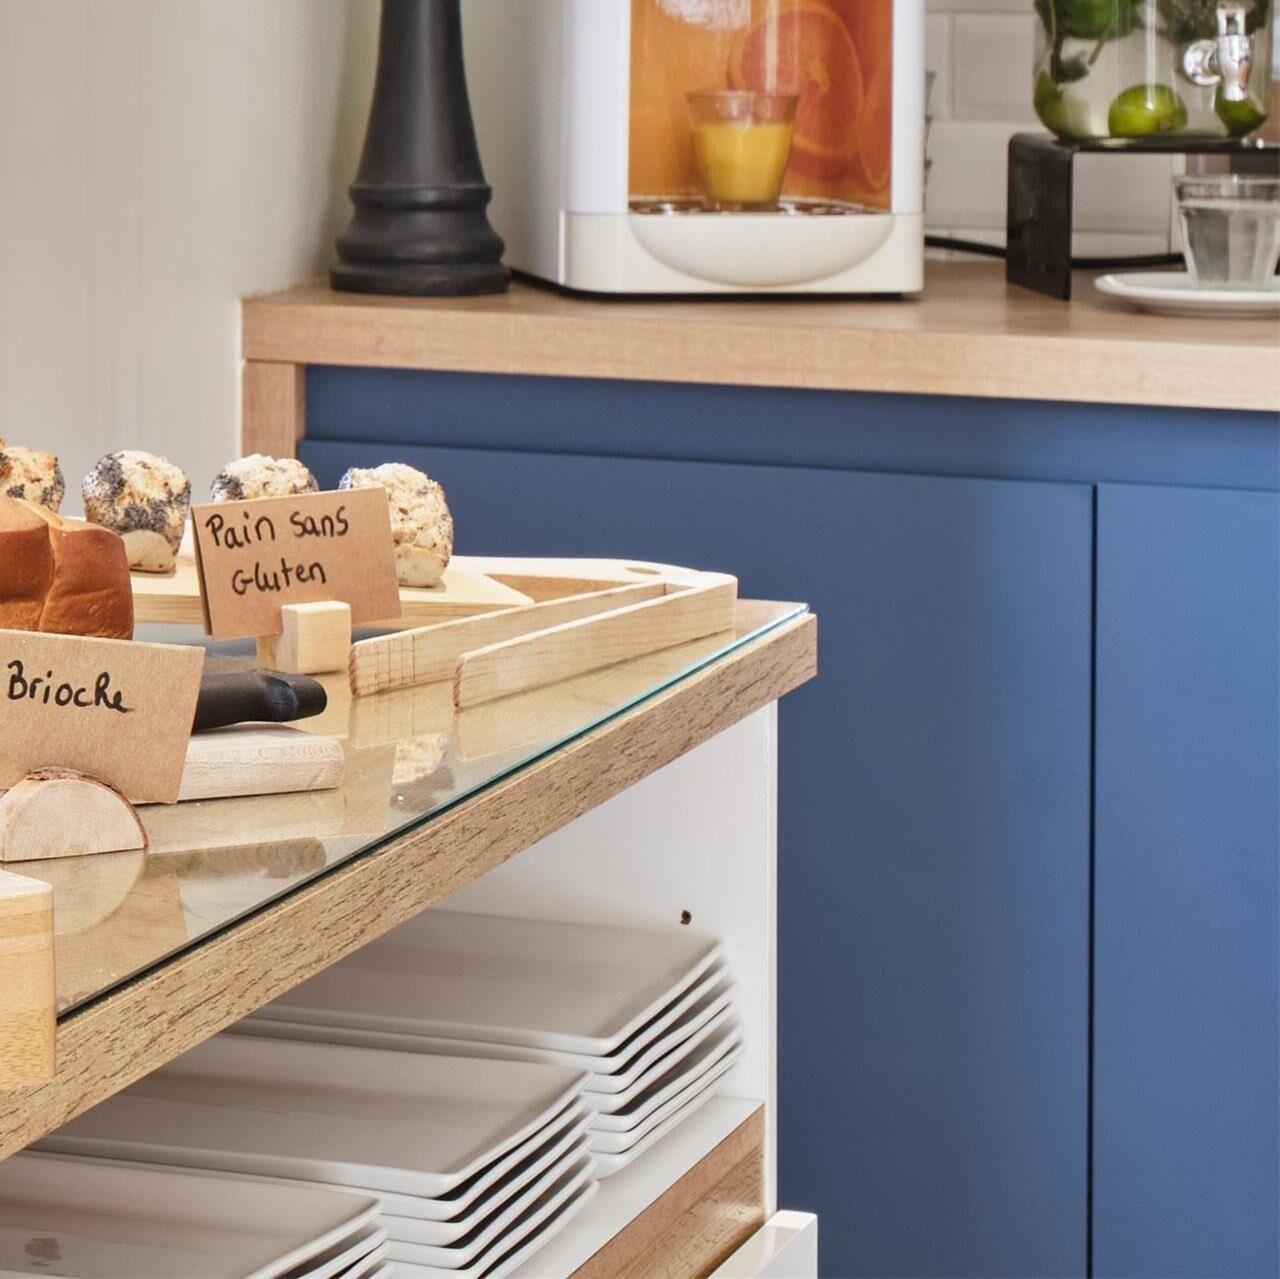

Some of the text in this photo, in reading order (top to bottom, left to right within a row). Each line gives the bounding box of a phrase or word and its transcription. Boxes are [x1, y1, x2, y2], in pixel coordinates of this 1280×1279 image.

[204, 513, 276, 549] Pain
[231, 557, 327, 596] Gluten
[7, 659, 135, 714] Brioche
